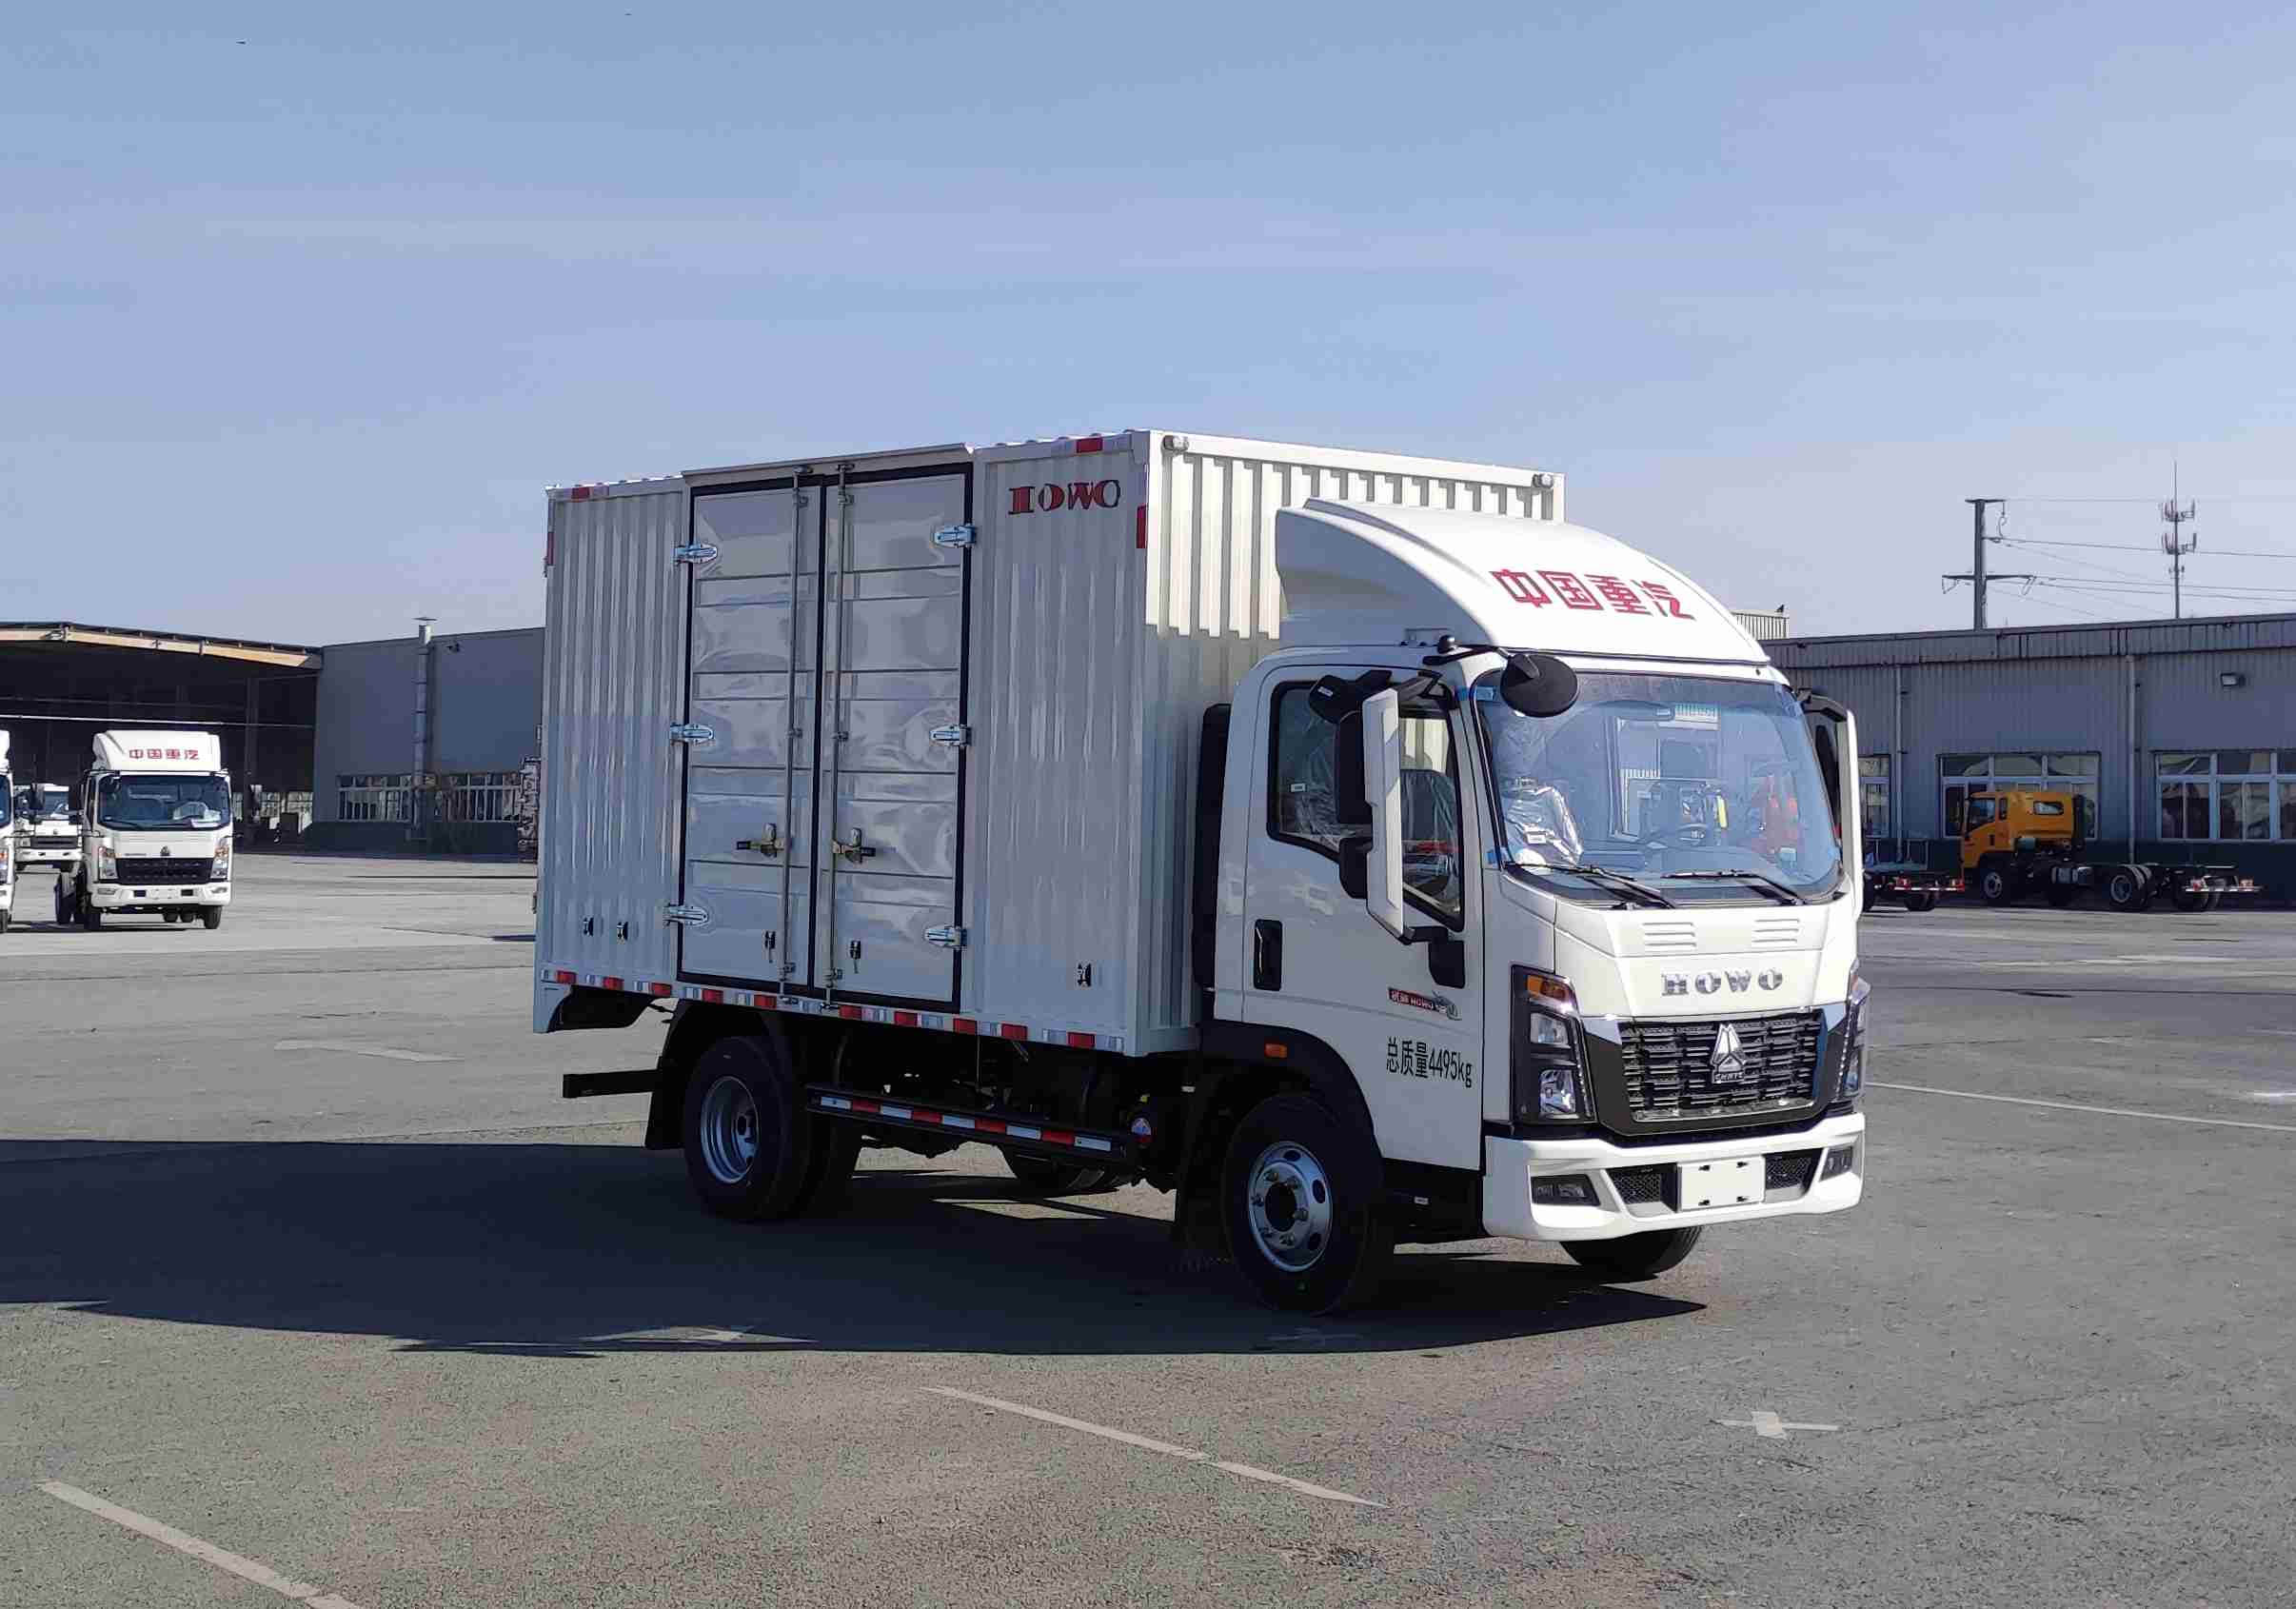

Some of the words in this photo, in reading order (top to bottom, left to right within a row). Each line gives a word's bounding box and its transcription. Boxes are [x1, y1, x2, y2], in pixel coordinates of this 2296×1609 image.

[1490, 569, 1696, 621] 中国重汽
[129, 748, 199, 760] 中国重汽
[1661, 968, 1783, 996] HOWO
[1387, 1037, 1473, 1088] 总质量4495kg
